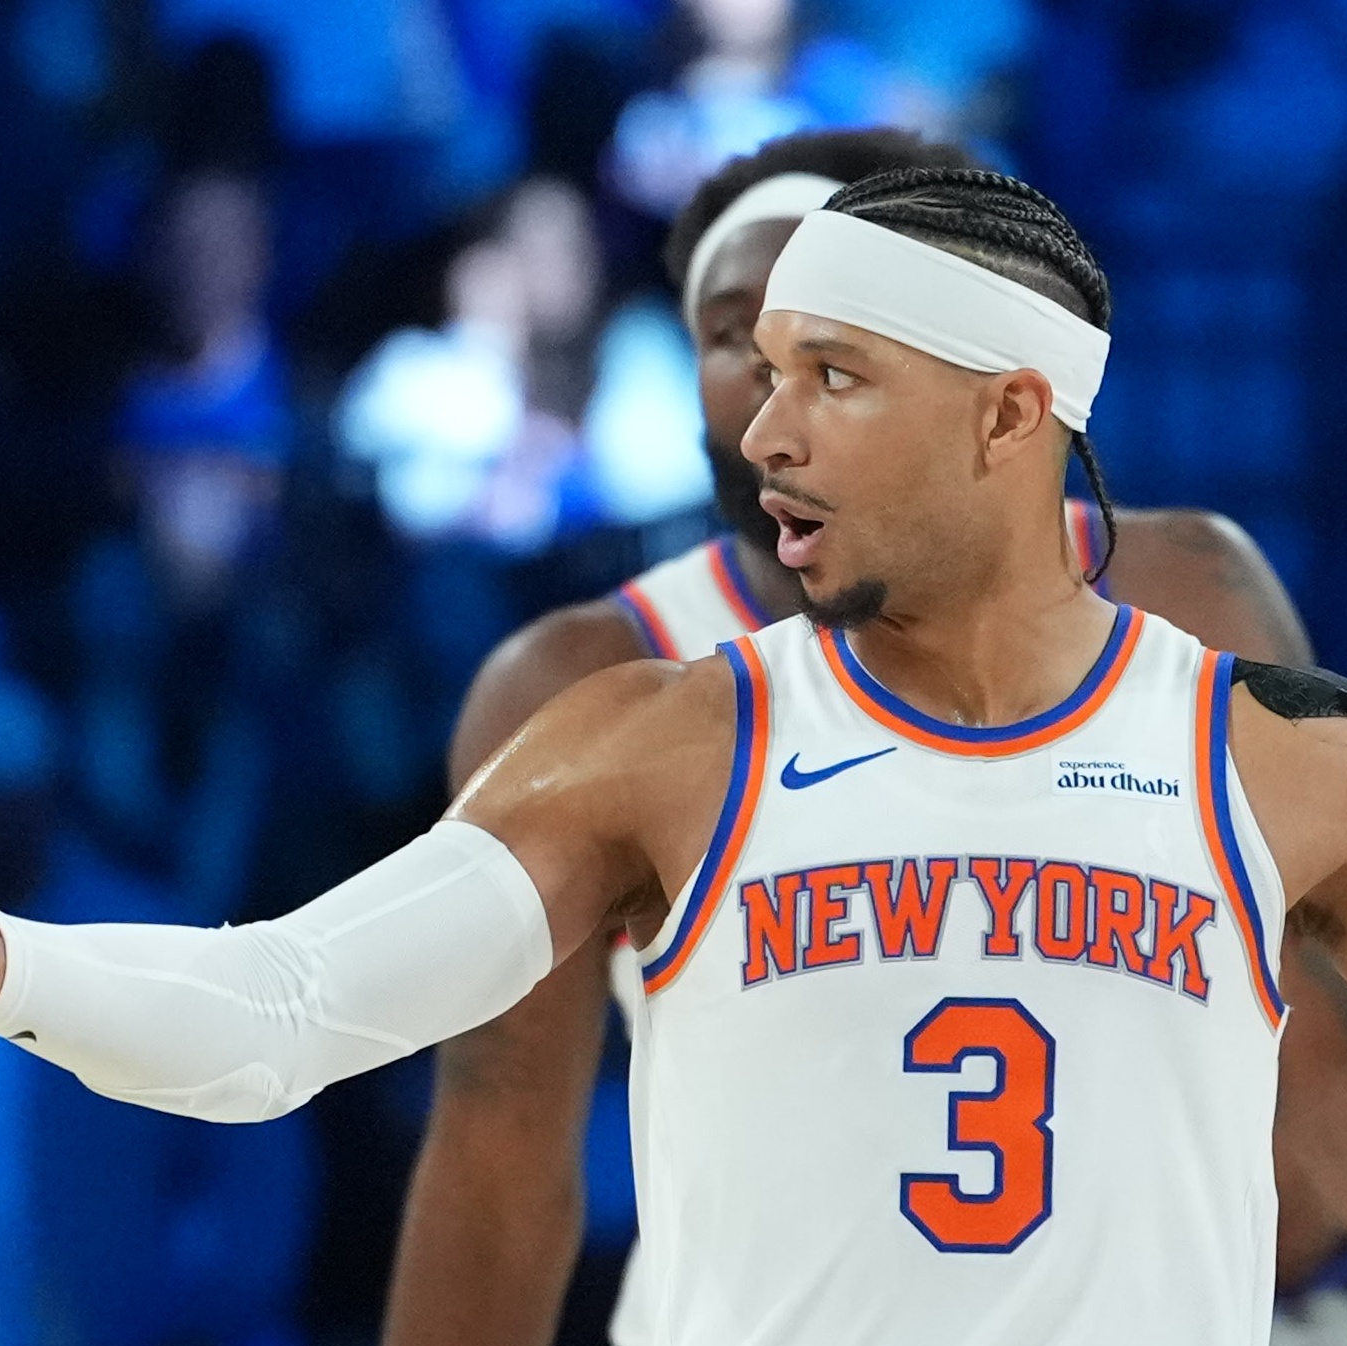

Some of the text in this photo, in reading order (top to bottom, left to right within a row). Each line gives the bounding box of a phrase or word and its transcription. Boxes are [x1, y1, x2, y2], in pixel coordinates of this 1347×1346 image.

[1057, 771, 1180, 797] abu dhabi
[1058, 760, 1126, 771] experience
[739, 853, 1221, 1006] NEW YORK
[899, 996, 1056, 1254] 3
